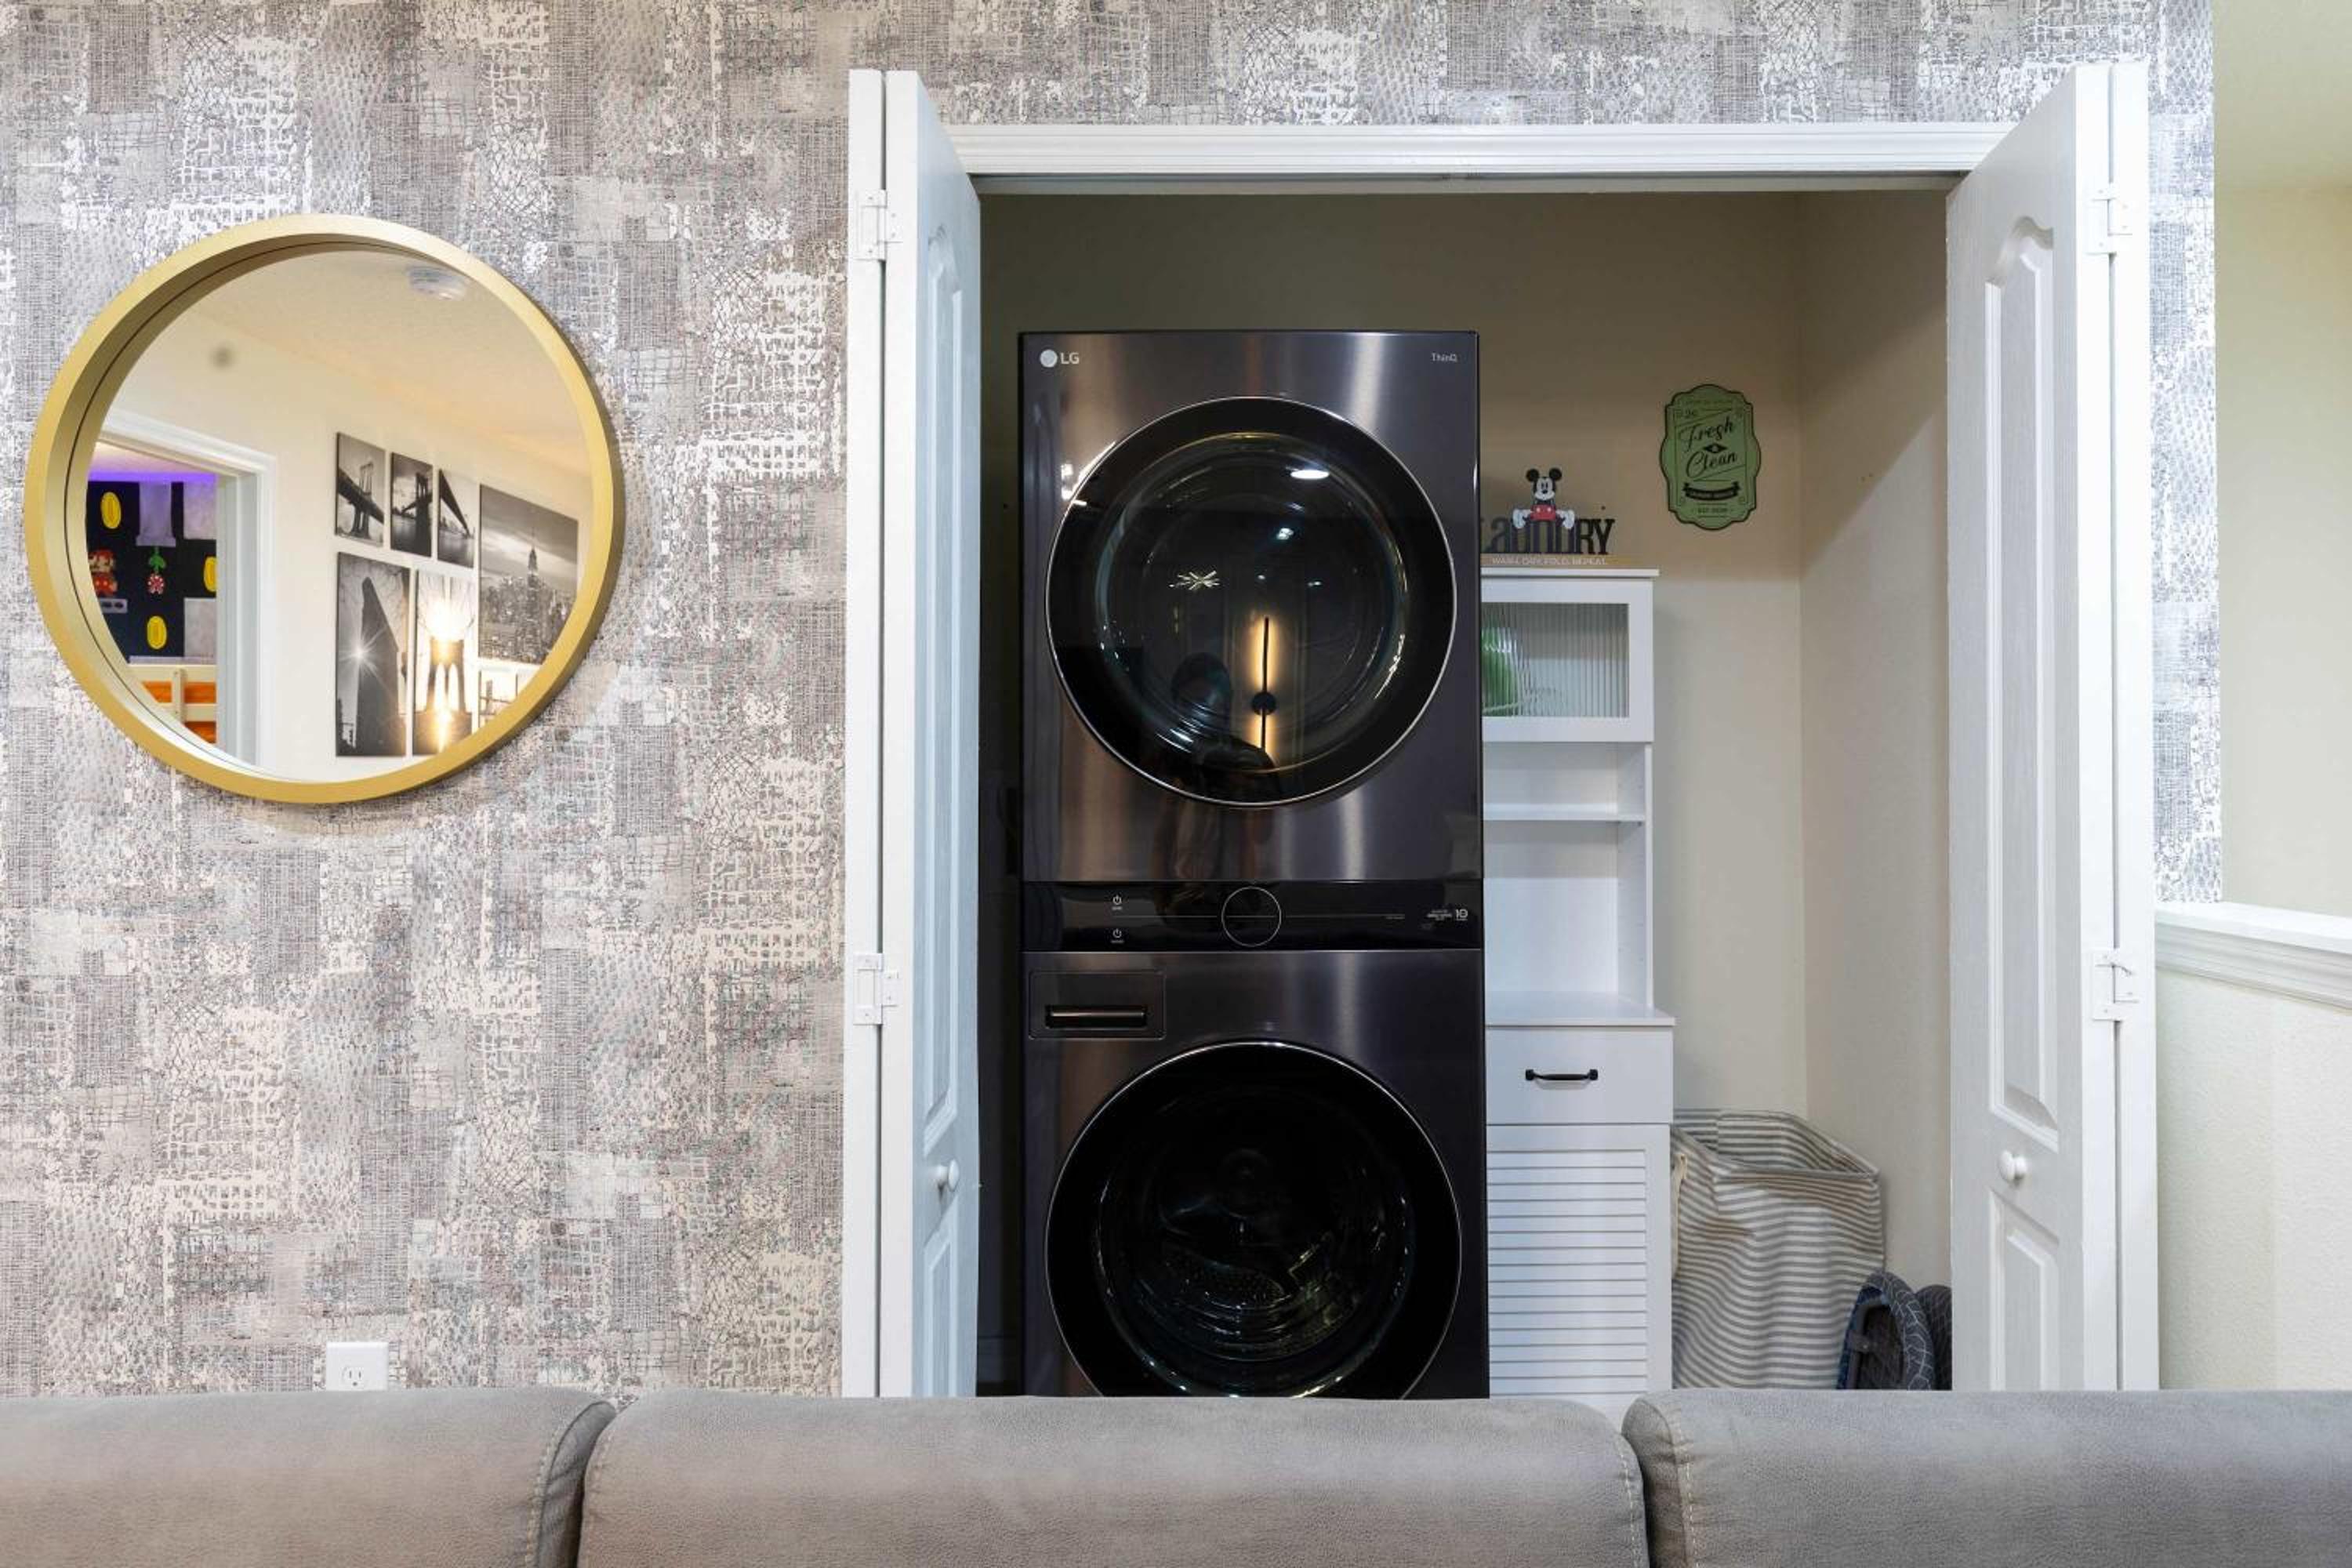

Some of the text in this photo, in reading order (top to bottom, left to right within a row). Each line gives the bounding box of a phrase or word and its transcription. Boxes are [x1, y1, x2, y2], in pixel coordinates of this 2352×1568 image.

[1061, 352, 1080, 365] LG
[1680, 416, 1734, 453] Fresh
[1686, 452, 1738, 478] Clean
